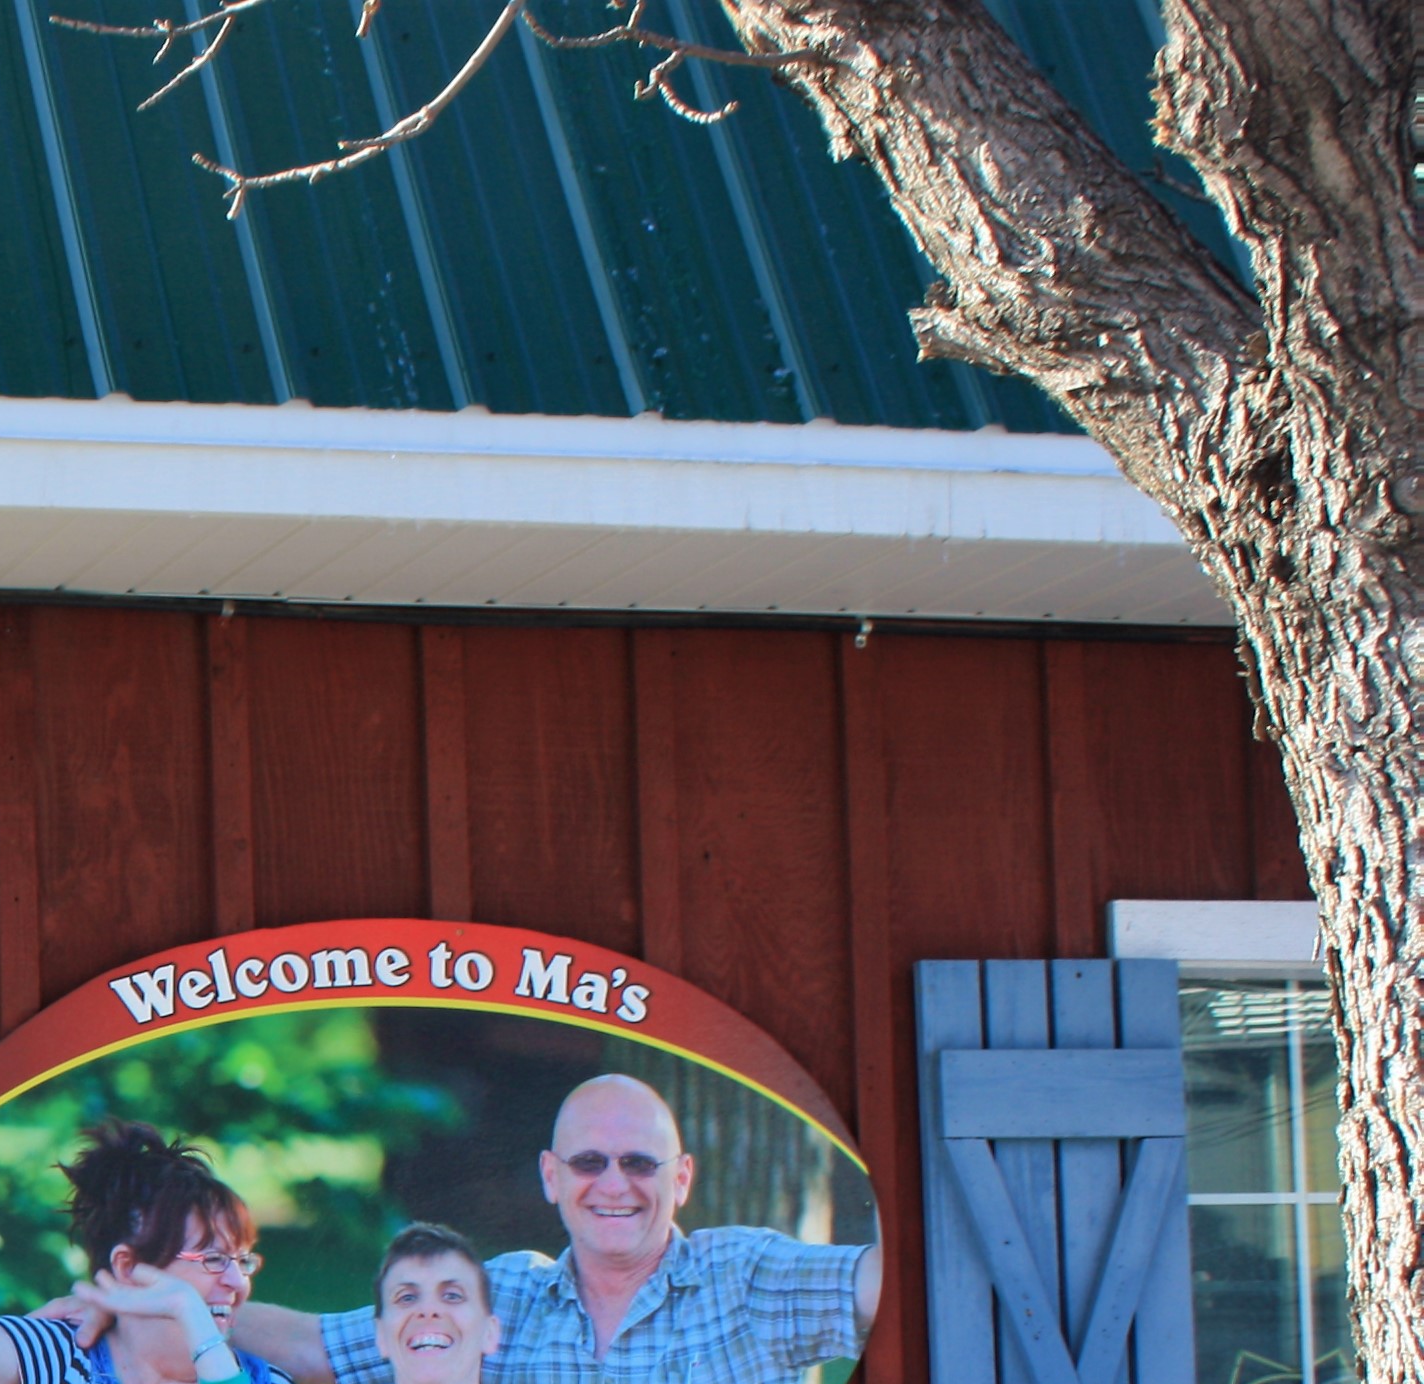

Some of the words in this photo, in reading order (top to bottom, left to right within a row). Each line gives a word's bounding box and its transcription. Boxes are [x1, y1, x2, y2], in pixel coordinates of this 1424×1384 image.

[109, 945, 411, 1025] Welcome
[428, 941, 495, 991] to
[513, 947, 651, 1025] Ma's
